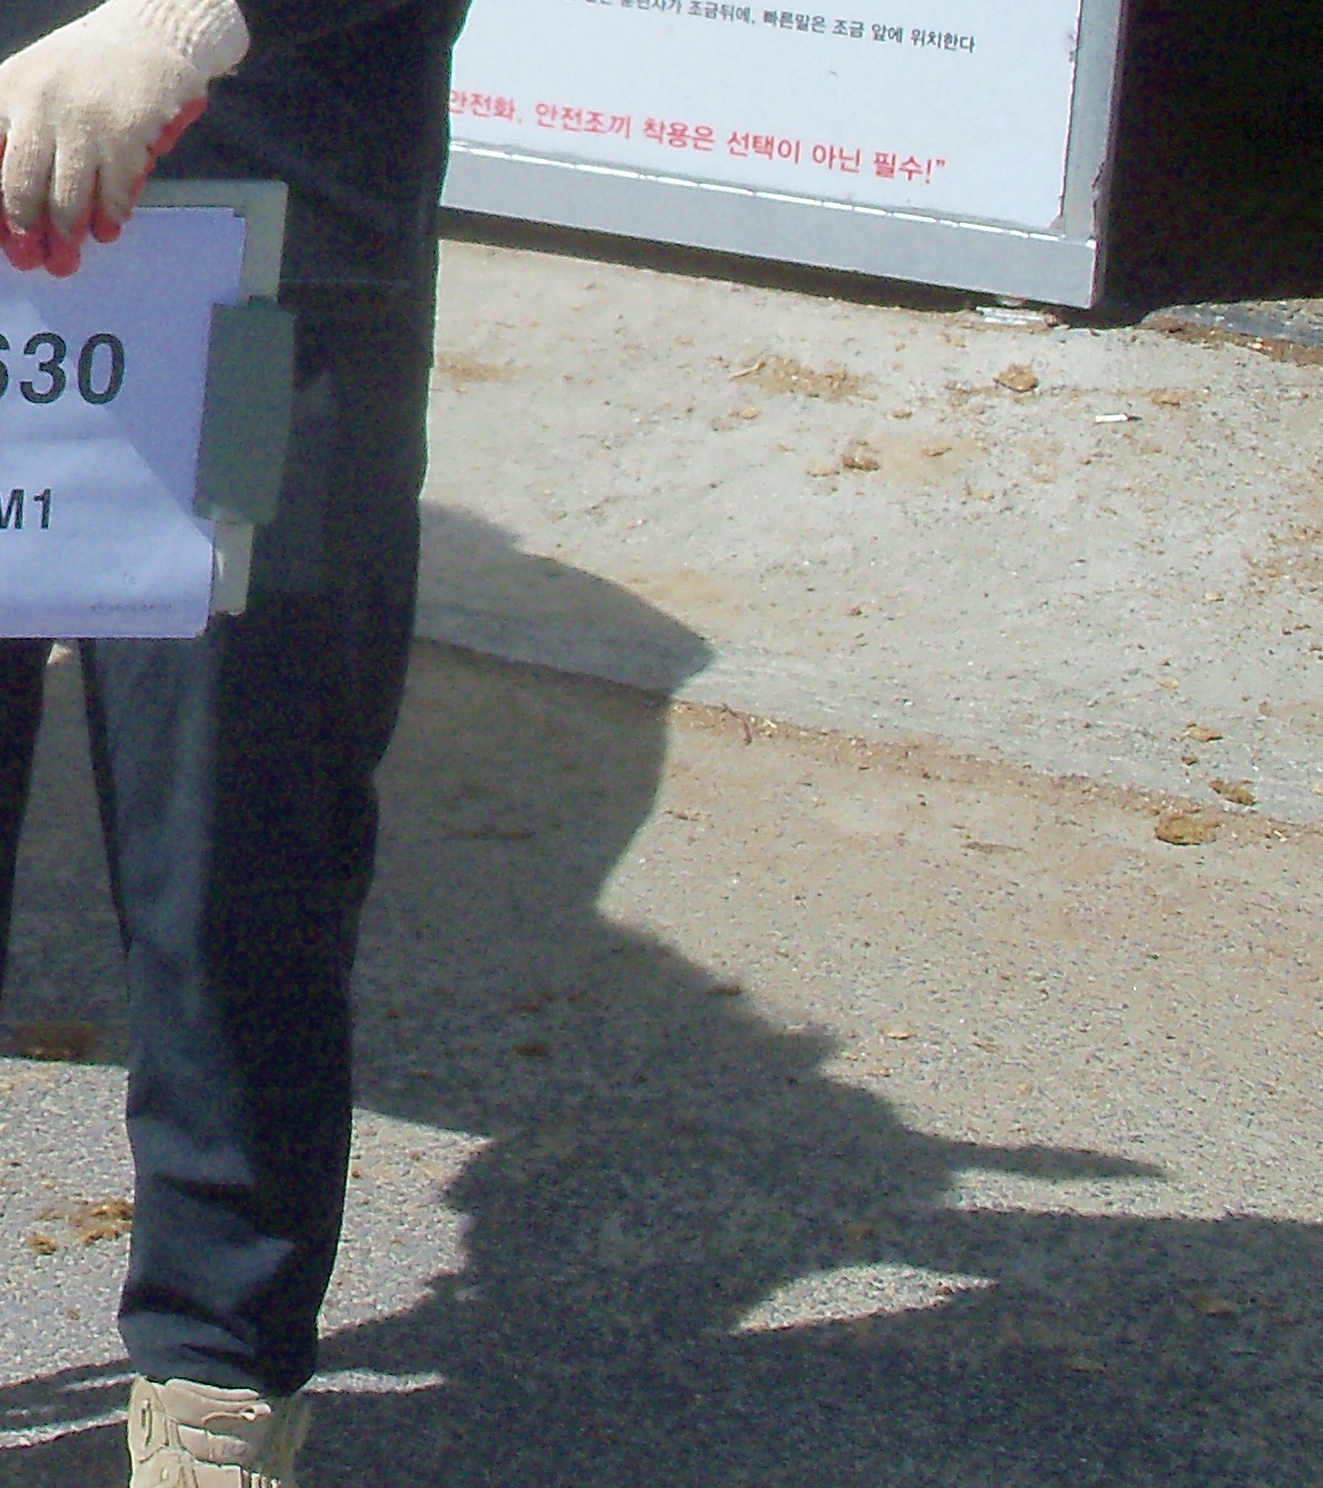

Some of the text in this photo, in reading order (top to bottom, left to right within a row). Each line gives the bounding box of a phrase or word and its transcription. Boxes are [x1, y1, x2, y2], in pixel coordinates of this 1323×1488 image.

[832, 19, 865, 39] 조금
[871, 23, 904, 43] 앞에
[910, 28, 976, 53] 위치한다
[535, 102, 631, 139] 안전조끼
[643, 118, 715, 152] 착용은
[727, 131, 801, 165] 선택이
[812, 144, 861, 174] 아닌
